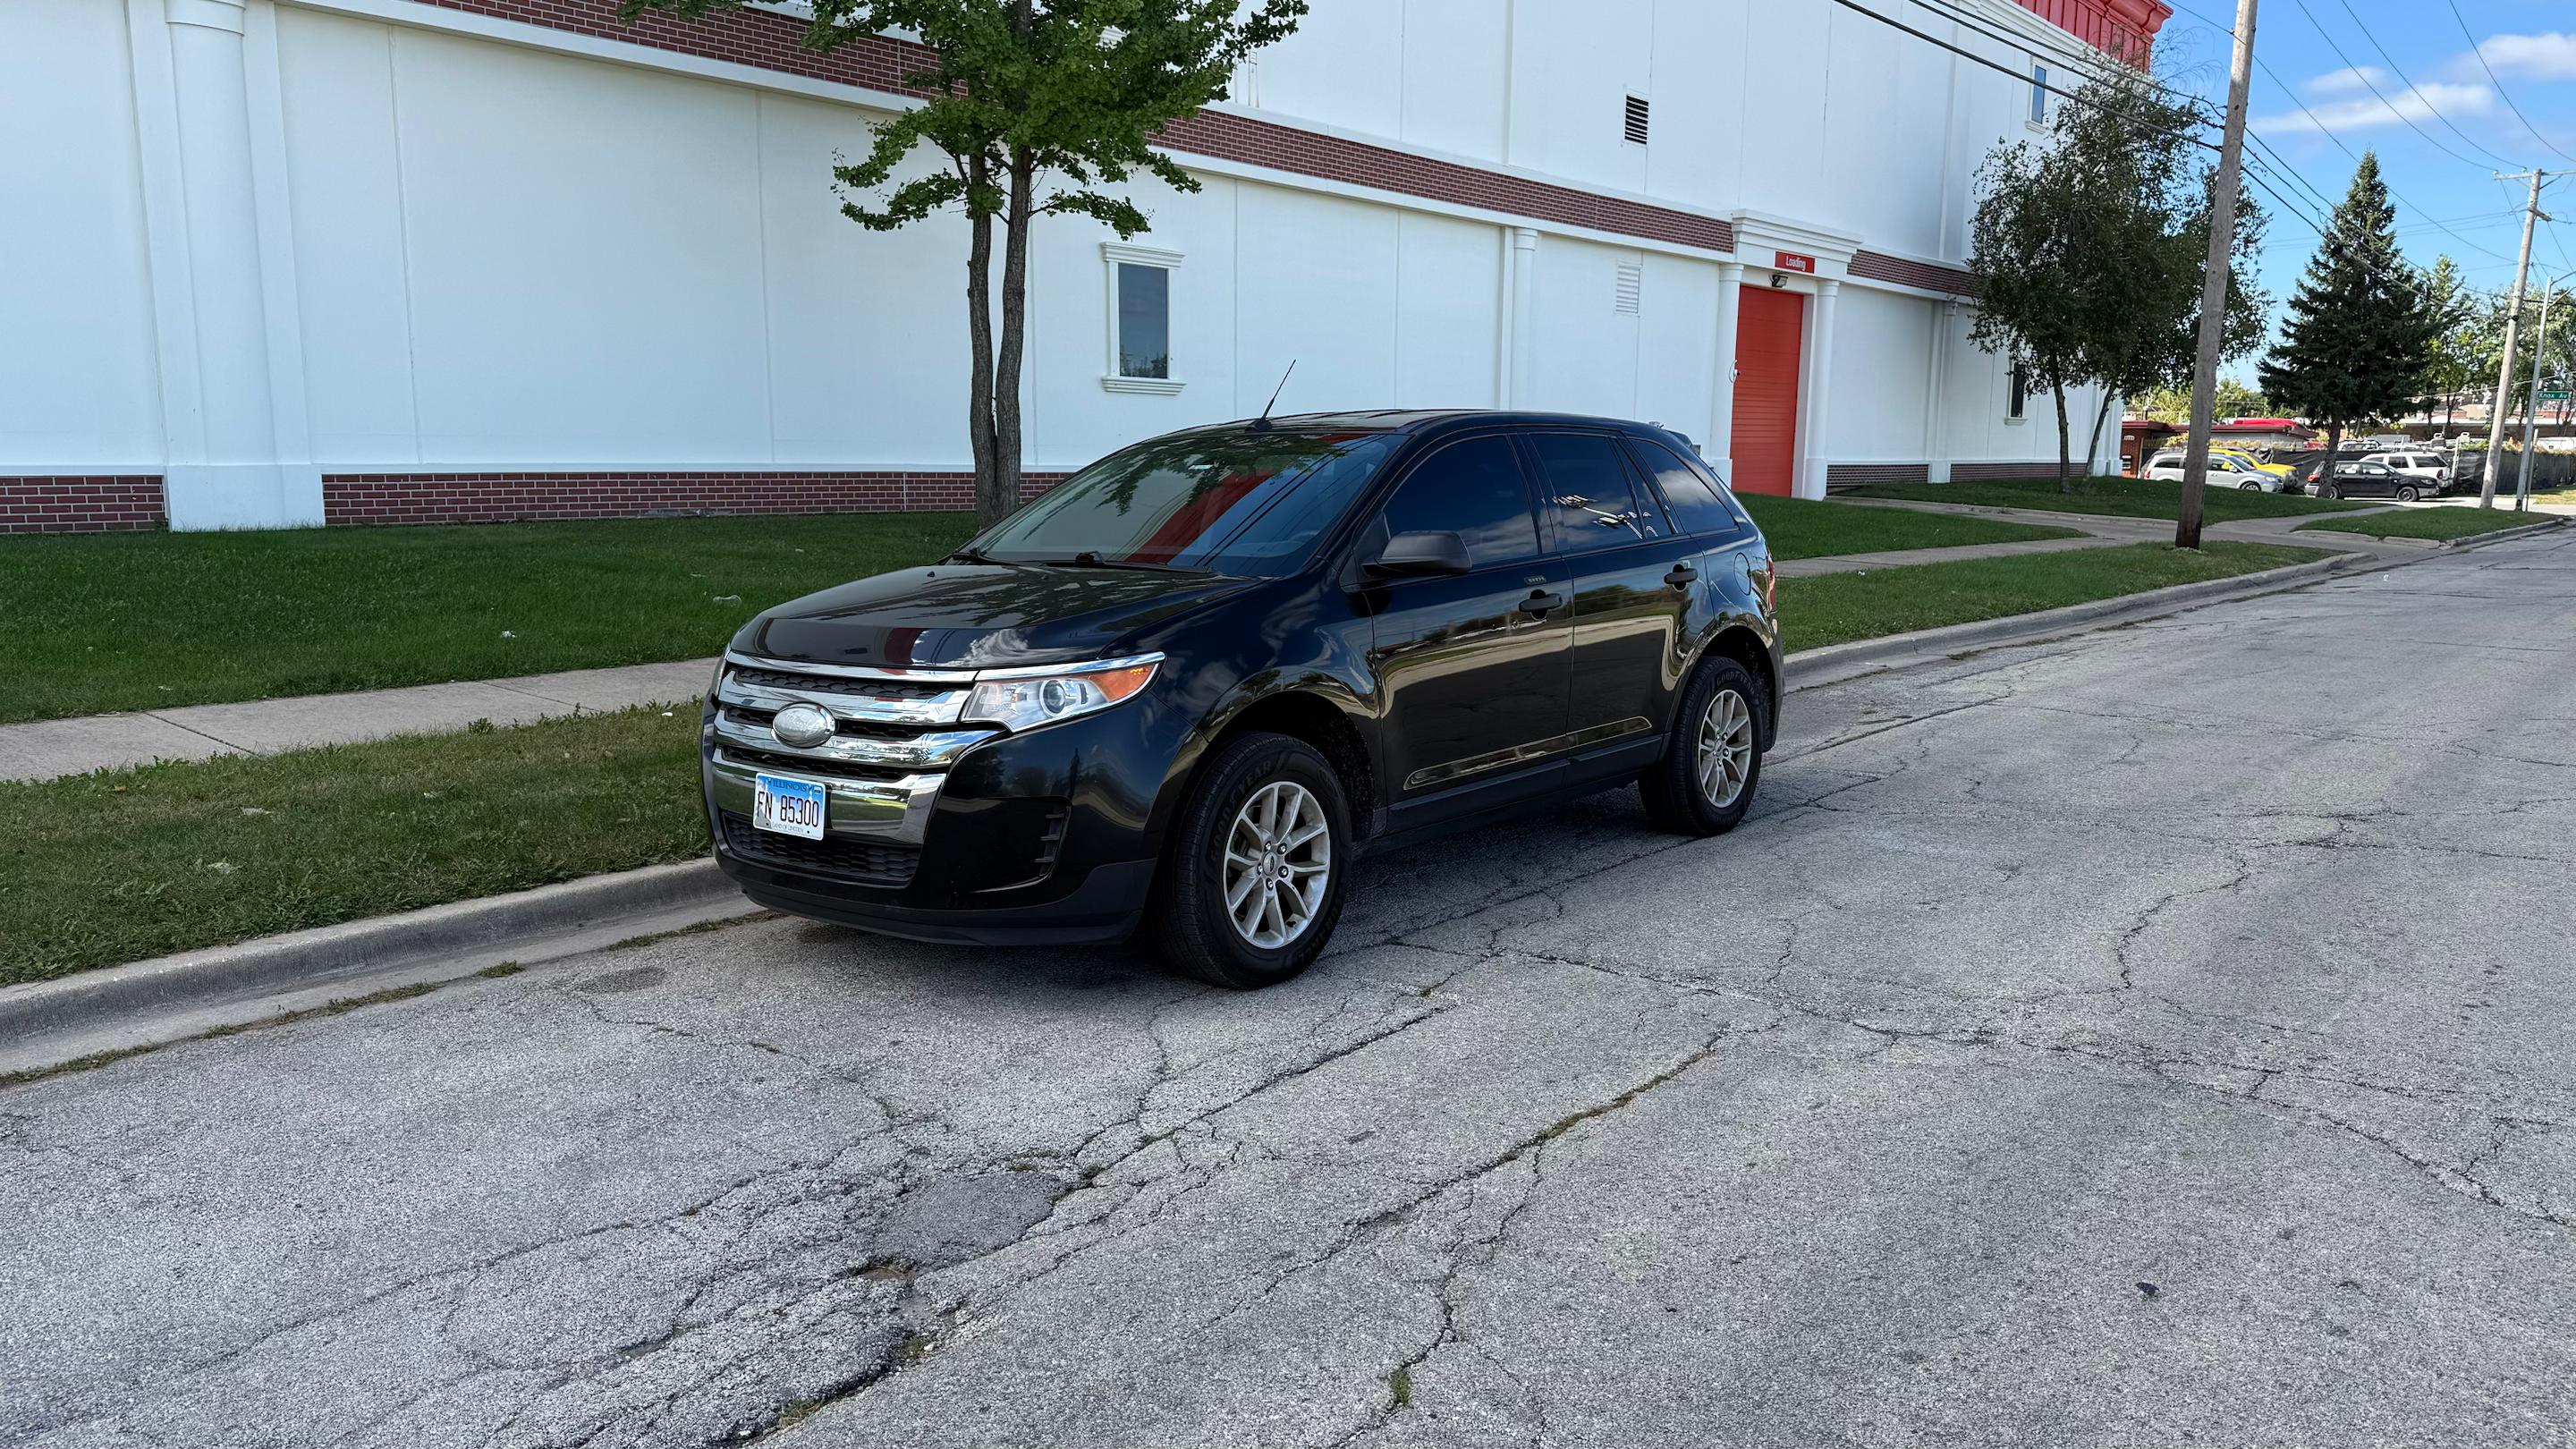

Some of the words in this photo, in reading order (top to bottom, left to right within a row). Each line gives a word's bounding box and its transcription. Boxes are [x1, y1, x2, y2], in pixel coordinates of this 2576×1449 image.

[1785, 255, 1806, 271] Loading
[773, 779, 808, 792] ILLINOIS
[757, 791, 773, 819] FN
[780, 794, 819, 827] 85300
[1210, 760, 1272, 860] GOODYEAR
